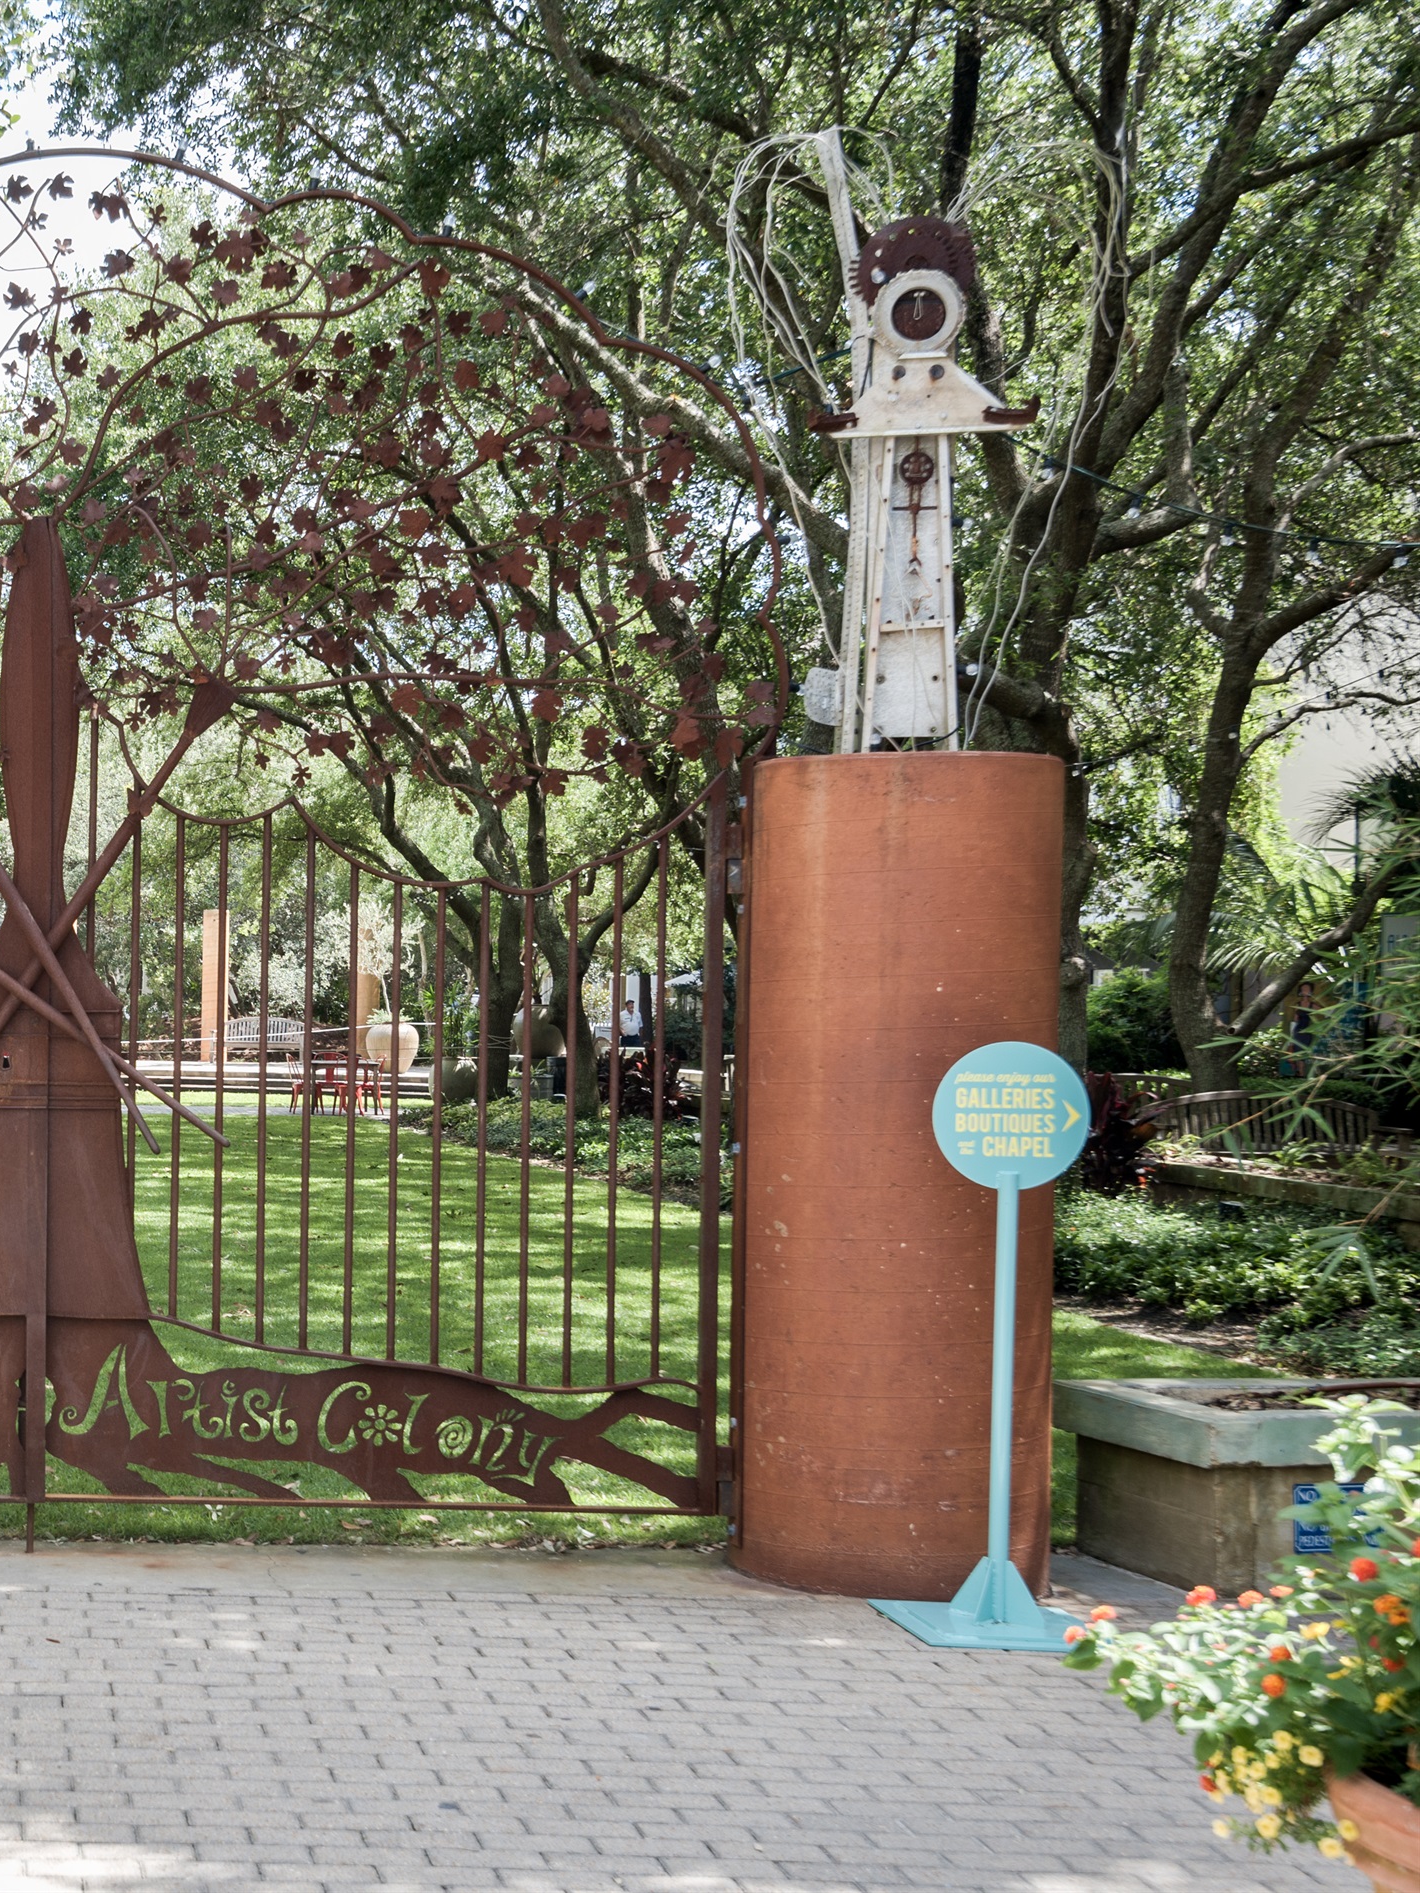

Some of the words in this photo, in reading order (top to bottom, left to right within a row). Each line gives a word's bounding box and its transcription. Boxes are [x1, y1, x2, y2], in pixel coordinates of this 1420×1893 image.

[954, 1071, 995, 1084] please
[996, 1072, 1031, 1086] enjoy
[1033, 1073, 1056, 1083] our
[955, 1088, 1056, 1110] GALLERIES
[955, 1113, 1056, 1134] BOUTIQUES
[982, 1136, 1054, 1158] CHAPEL
[58, 1343, 298, 1446] Artist
[317, 1380, 564, 1486] Colony
[1297, 1490, 1317, 1502] NO
